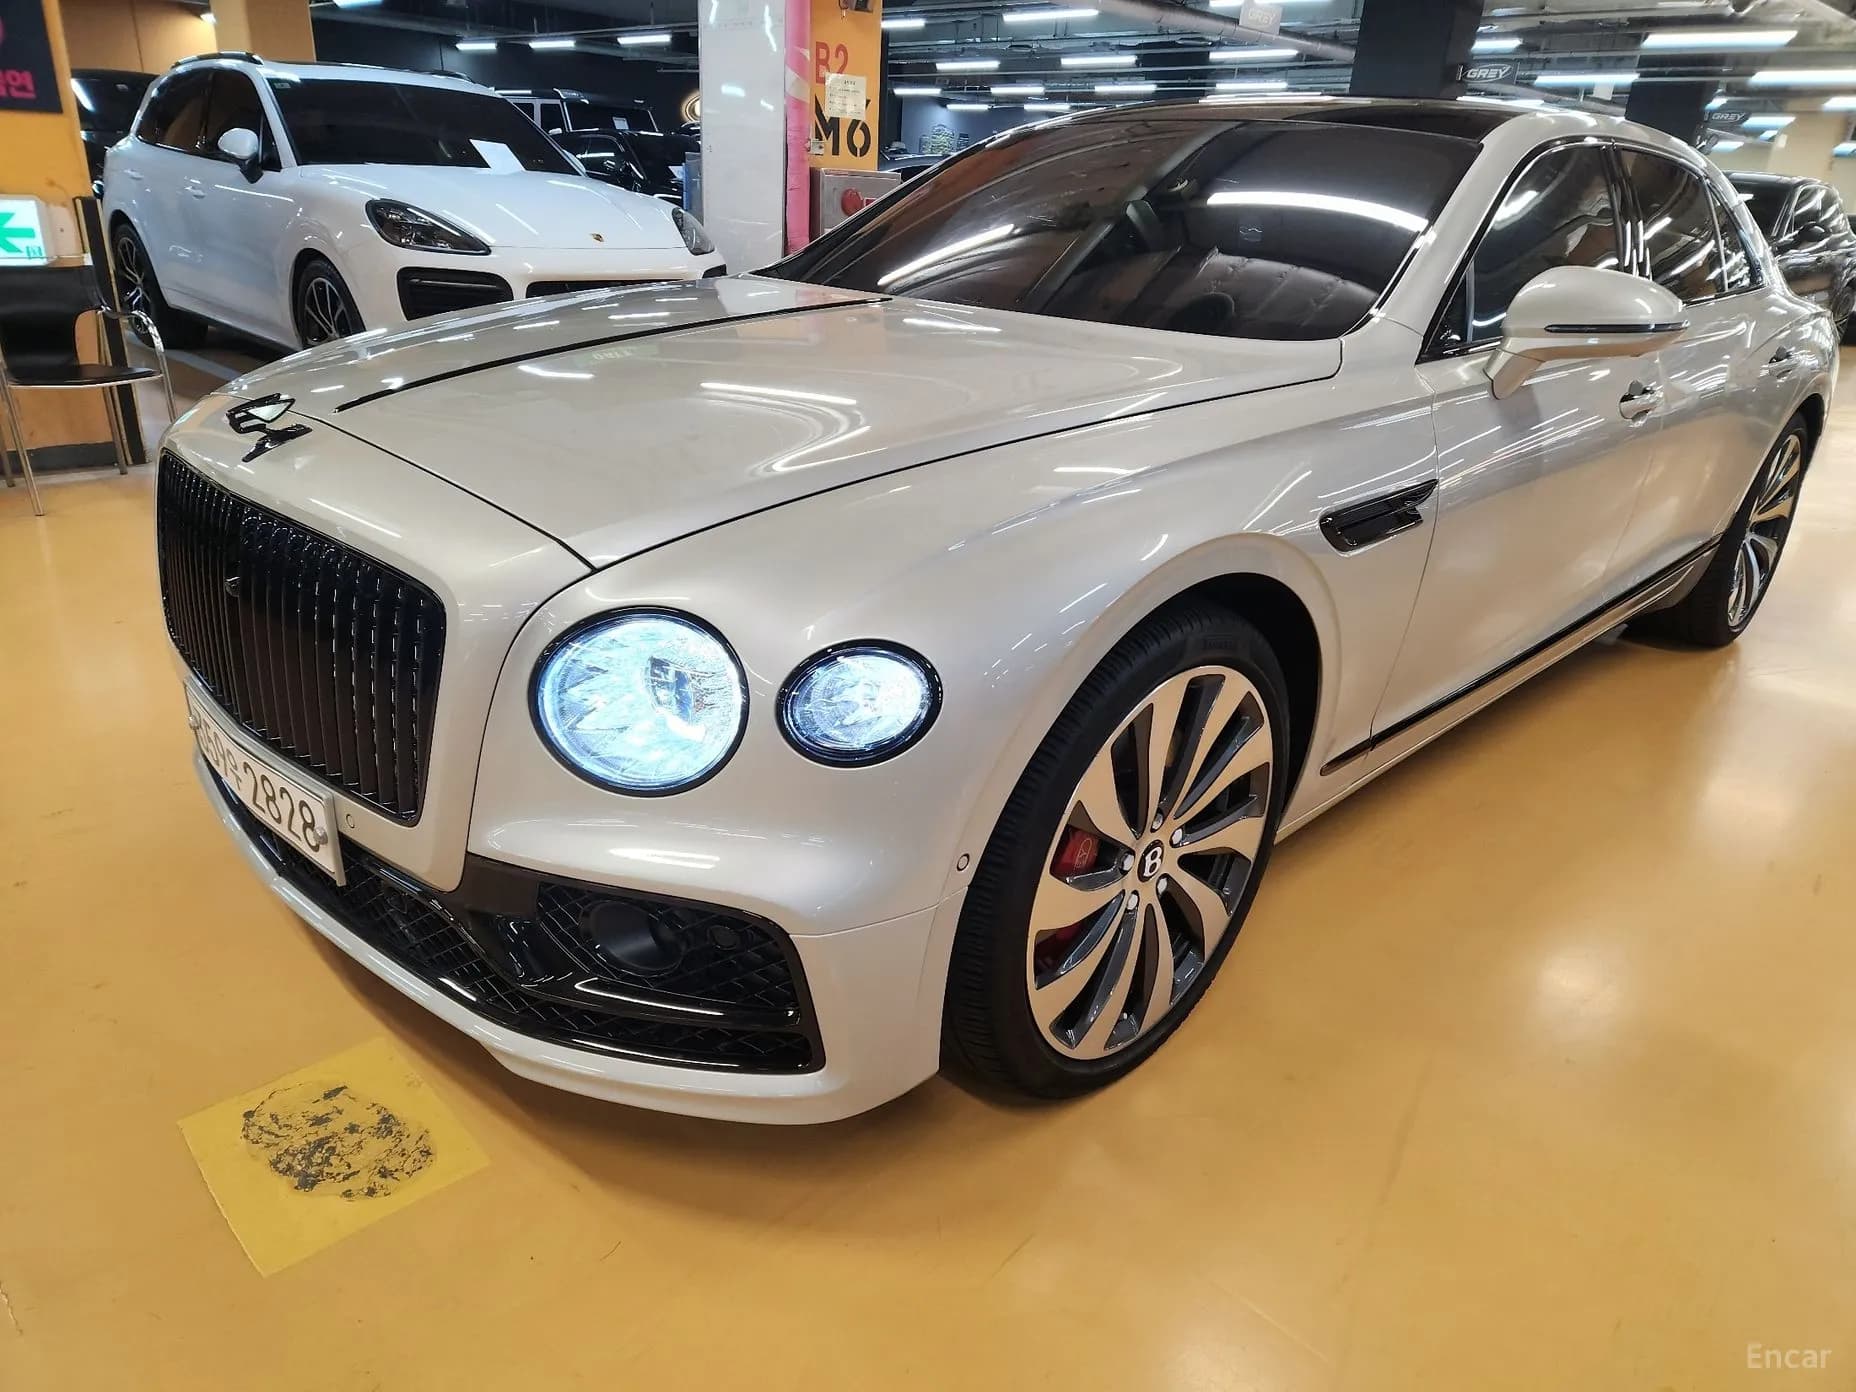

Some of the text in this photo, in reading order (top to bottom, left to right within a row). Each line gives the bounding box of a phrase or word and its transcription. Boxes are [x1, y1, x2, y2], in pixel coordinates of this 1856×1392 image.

[815, 41, 848, 84] B2
[1466, 65, 1511, 79] GREY
[1712, 112, 1745, 121] GREY
[243, 761, 320, 853] 2828
[1143, 846, 1162, 877] B
